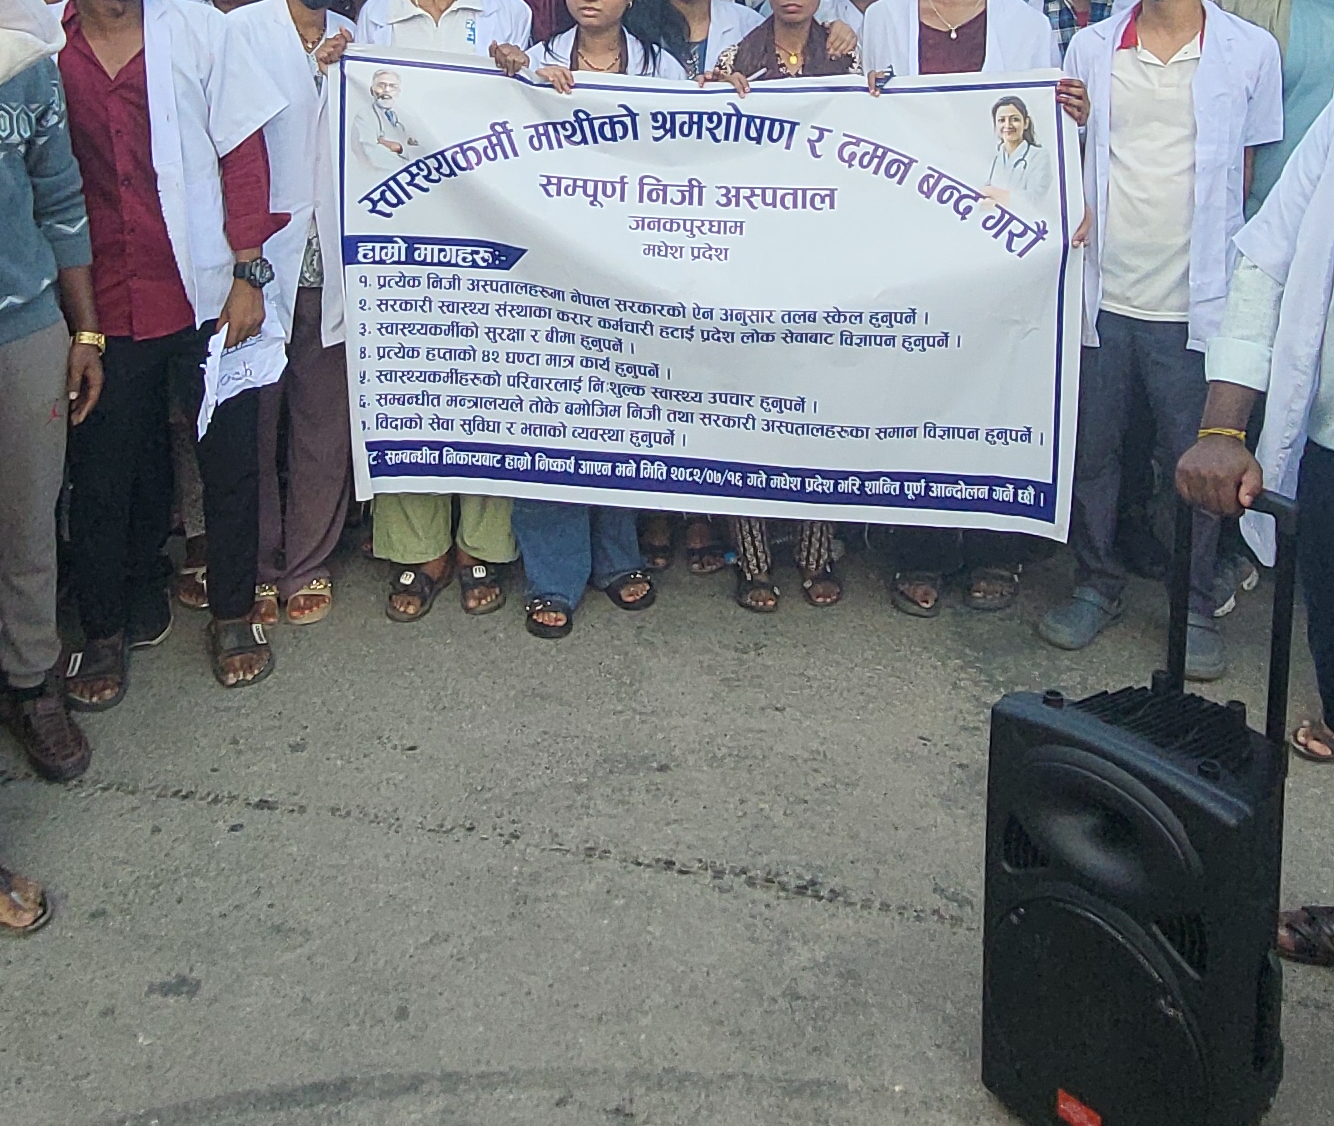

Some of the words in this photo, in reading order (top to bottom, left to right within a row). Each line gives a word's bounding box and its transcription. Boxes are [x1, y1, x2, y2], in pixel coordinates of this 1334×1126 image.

[524, 103, 639, 152] माथीको
[650, 102, 800, 150] श्रमशोषण
[807, 125, 833, 158] र
[837, 133, 918, 186] दमन
[918, 166, 992, 221] बन्द
[539, 174, 629, 208] सम्पूर्ण
[638, 175, 706, 207] निजी
[715, 185, 838, 211] अस्पताल
[357, 238, 406, 263] हाम्रो
[690, 242, 730, 262] प्रदेश
[377, 271, 423, 290] प्रत्येक
[427, 273, 462, 291] निजी
[569, 288, 610, 309] नेपाल
[614, 298, 687, 318] सरकारको
[692, 302, 714, 321] ऐन
[719, 308, 776, 326] अनुसार
[781, 310, 818, 325] तलब
[822, 306, 864, 325] स्केल
[376, 296, 433, 313] सरकारी
[438, 301, 489, 316] स्वास्थ्य
[495, 301, 551, 320] संस्थाका
[556, 309, 593, 328] करार
[597, 317, 654, 336] कर्मचारी
[659, 325, 695, 342] हटाई
[700, 327, 735, 344] प्रदेश
[740, 329, 776, 344] लोक
[781, 329, 835, 345] सेवाबाट
[840, 330, 897, 348] विज्ञापन
[484, 326, 524, 343] सुरक्षा
[530, 329, 541, 343] र
[545, 326, 575, 345] बीमा
[376, 342, 421, 361] प्रत्येक
[425, 345, 477, 363] हप्ताको
[505, 352, 541, 367] घण्टा
[545, 354, 575, 369] मात्र
[580, 356, 610, 372] कार्य
[506, 372, 583, 395] परिवारलाई
[650, 387, 703, 404] स्वास्थ्य
[708, 392, 756, 408] उपचार
[428, 414, 454, 432] सेवा
[506, 422, 517, 436] र
[571, 426, 624, 443] व्यवस्था
[446, 395, 524, 412] मन्त्रालयले
[529, 396, 560, 414] तोके
[565, 398, 622, 419] बमोजिम
[626, 402, 662, 422] निजी
[667, 409, 694, 424] तथा
[699, 413, 756, 431] सरकारी
[875, 426, 919, 442] समान
[924, 422, 980, 441] विज्ञापन
[443, 447, 502, 468] निकायबाट
[504, 452, 531, 471] हाम्रो
[535, 453, 575, 475] निष्कर्ष
[578, 461, 612, 477] आएन
[616, 460, 636, 479] भने
[639, 460, 667, 481] मिति
[747, 471, 766, 488] गते
[805, 474, 834, 493] प्रदेश
[838, 476, 861, 495] भरि
[865, 477, 900, 496] शान्ति
[904, 479, 925, 500] पूर्ण
[929, 481, 989, 500] आन्दोलन
